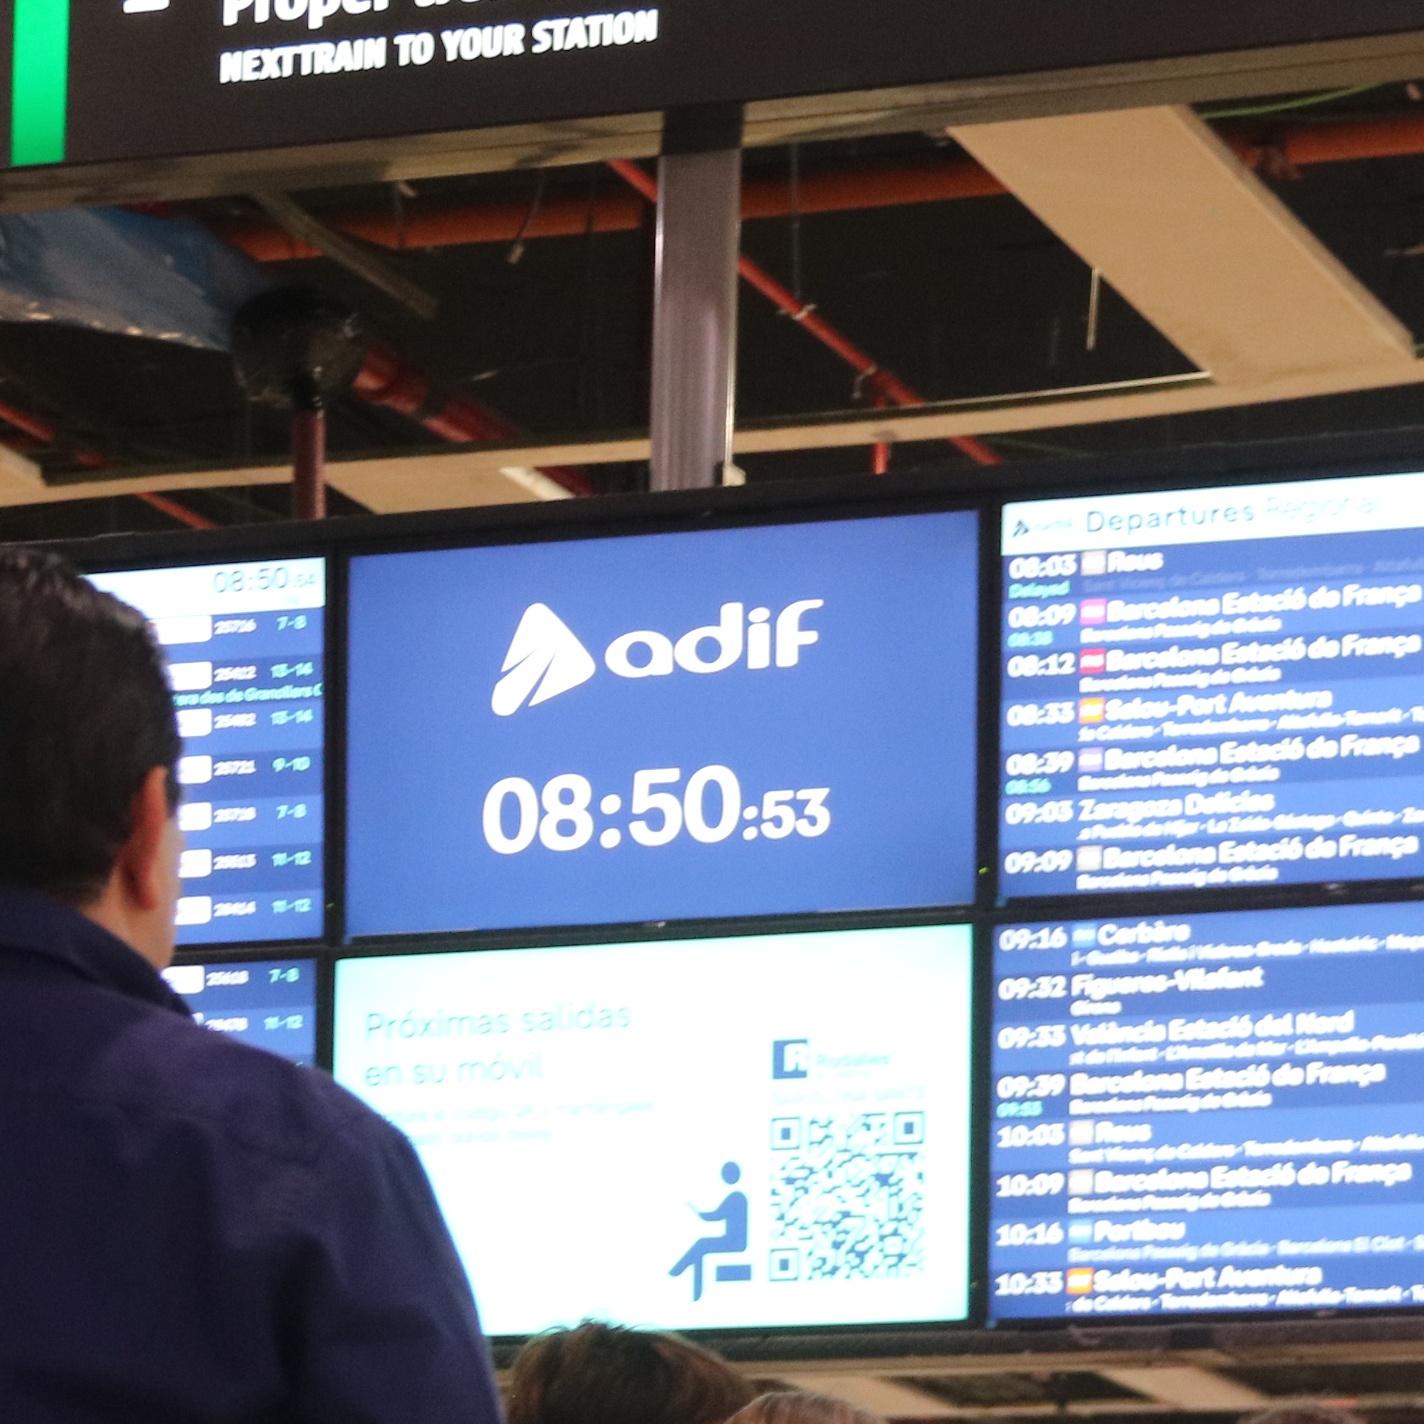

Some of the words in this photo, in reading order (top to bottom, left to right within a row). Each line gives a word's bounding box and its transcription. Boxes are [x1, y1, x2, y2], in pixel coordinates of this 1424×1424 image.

[394, 33, 434, 67] TO
[442, 23, 524, 62] YOUR
[532, 9, 659, 54] STATION
[1087, 503, 1254, 535] Departures
[1009, 554, 1077, 578] 08:03
[1108, 551, 1163, 572] Reus
[1009, 603, 1076, 628] 08:09
[1107, 596, 1220, 622] Barcelona
[1222, 587, 1307, 614] Estació
[1308, 586, 1341, 609] de
[1343, 584, 1422, 607] França
[604, 599, 824, 678] adif
[1008, 653, 1075, 677] 08:12
[1107, 646, 1219, 671] Barcelona
[1221, 637, 1306, 664] Estació
[1307, 636, 1340, 659] de
[1342, 634, 1421, 657] França
[1007, 702, 1075, 726] 08:33
[1106, 694, 1227, 721] Salou-Port
[1228, 690, 1332, 713] Aventura
[483, 764, 831, 854] 08:50:53
[1006, 800, 1073, 824] 09:03
[1078, 799, 1183, 822] Zaragoza
[1000, 927, 1067, 950] 09:16
[1097, 921, 1191, 945] Cerbère
[365, 1006, 512, 1041] Próximas
[520, 1000, 632, 1034] salidas
[998, 1025, 1066, 1049] 09:33
[1070, 1020, 1167, 1045] València
[1168, 1015, 1252, 1041] Estació
[1252, 1013, 1294, 1037] del
[1296, 1010, 1354, 1034] Nord
[365, 1063, 403, 1088] en
[410, 1061, 448, 1086] su
[456, 1050, 544, 1083] móvil
[996, 1222, 1064, 1246] 10:16
[1094, 1219, 1185, 1242] Portbou
